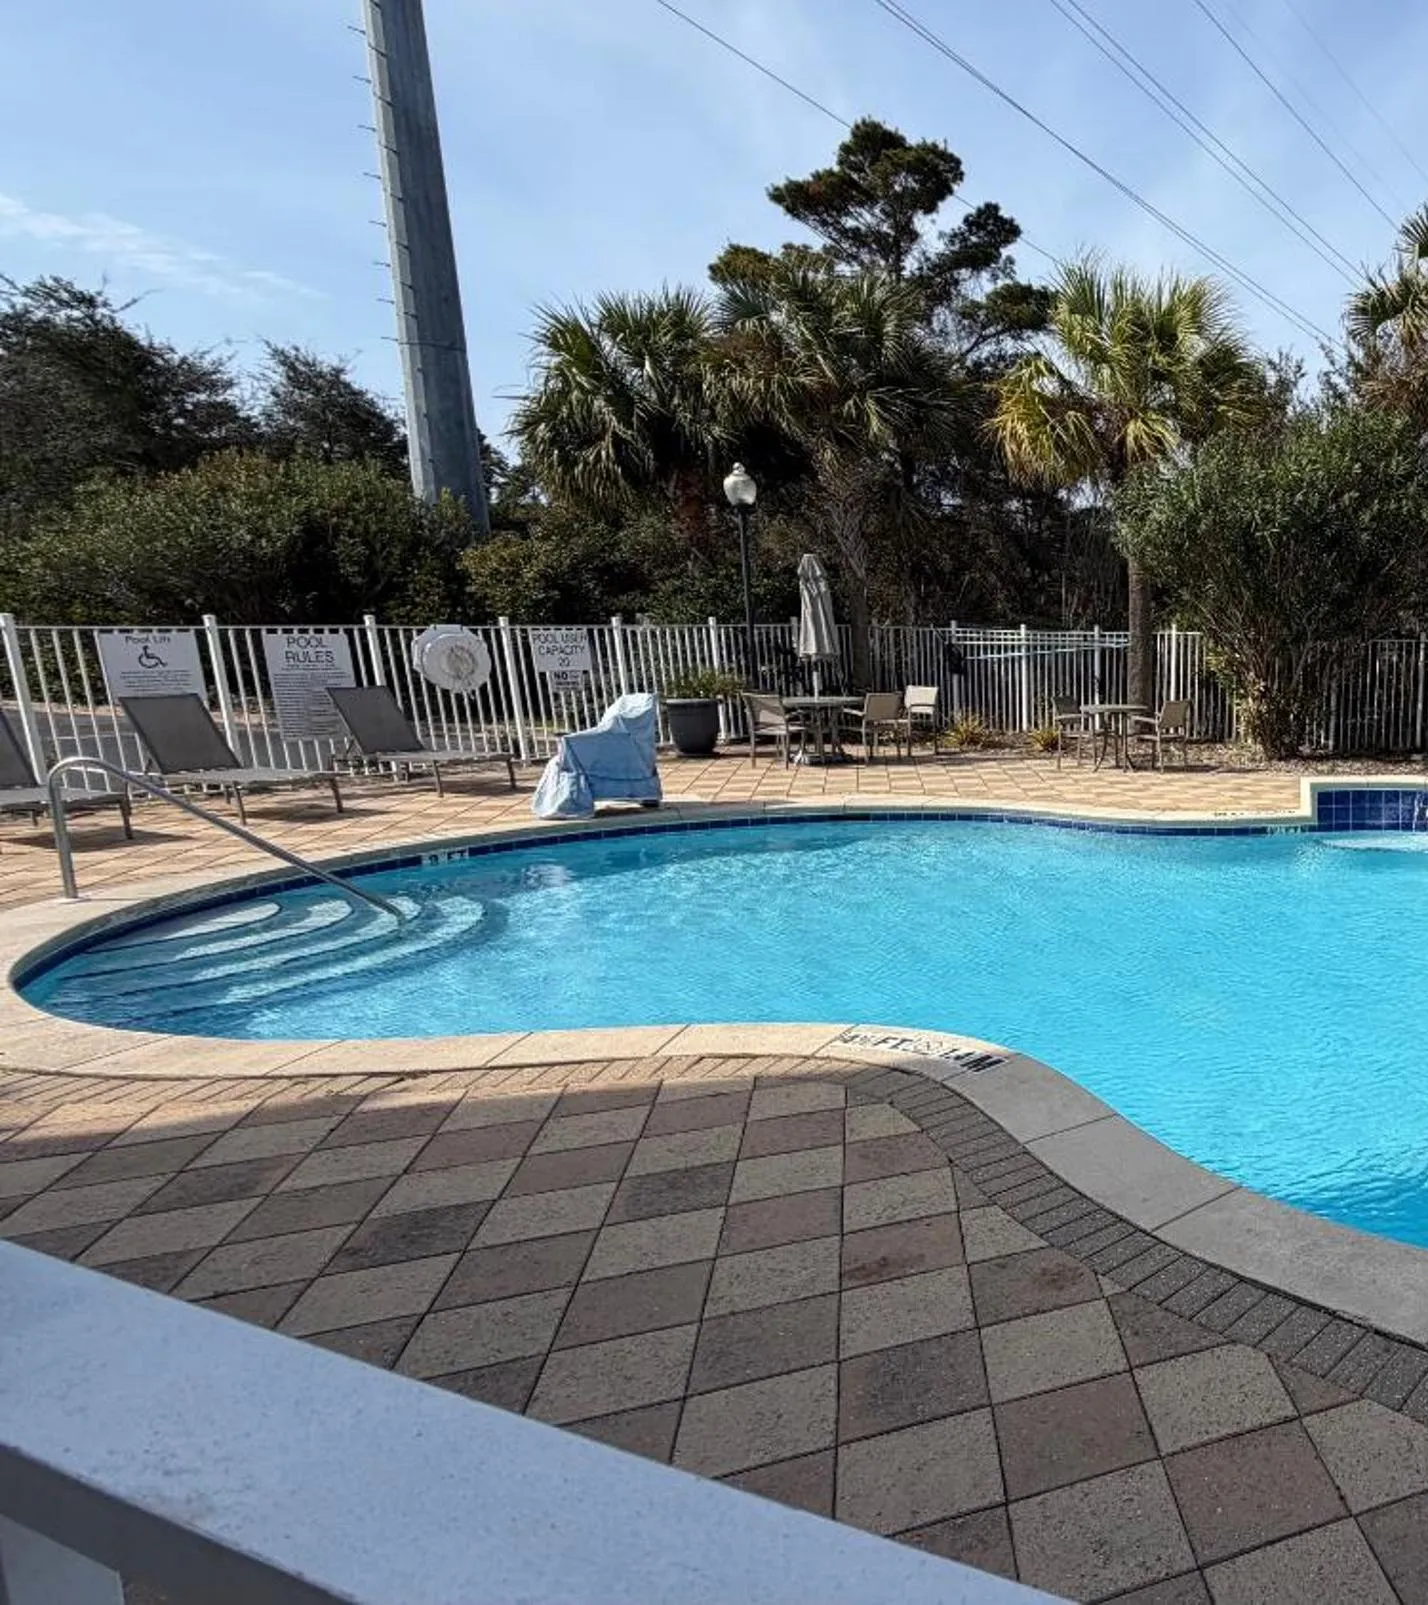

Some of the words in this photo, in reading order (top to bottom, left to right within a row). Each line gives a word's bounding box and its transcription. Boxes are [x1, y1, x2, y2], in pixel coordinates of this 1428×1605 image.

[125, 635, 149, 644] Pool
[286, 635, 328, 649] POOL
[538, 644, 585, 655] CAPACITY
[284, 650, 334, 664] RULES
